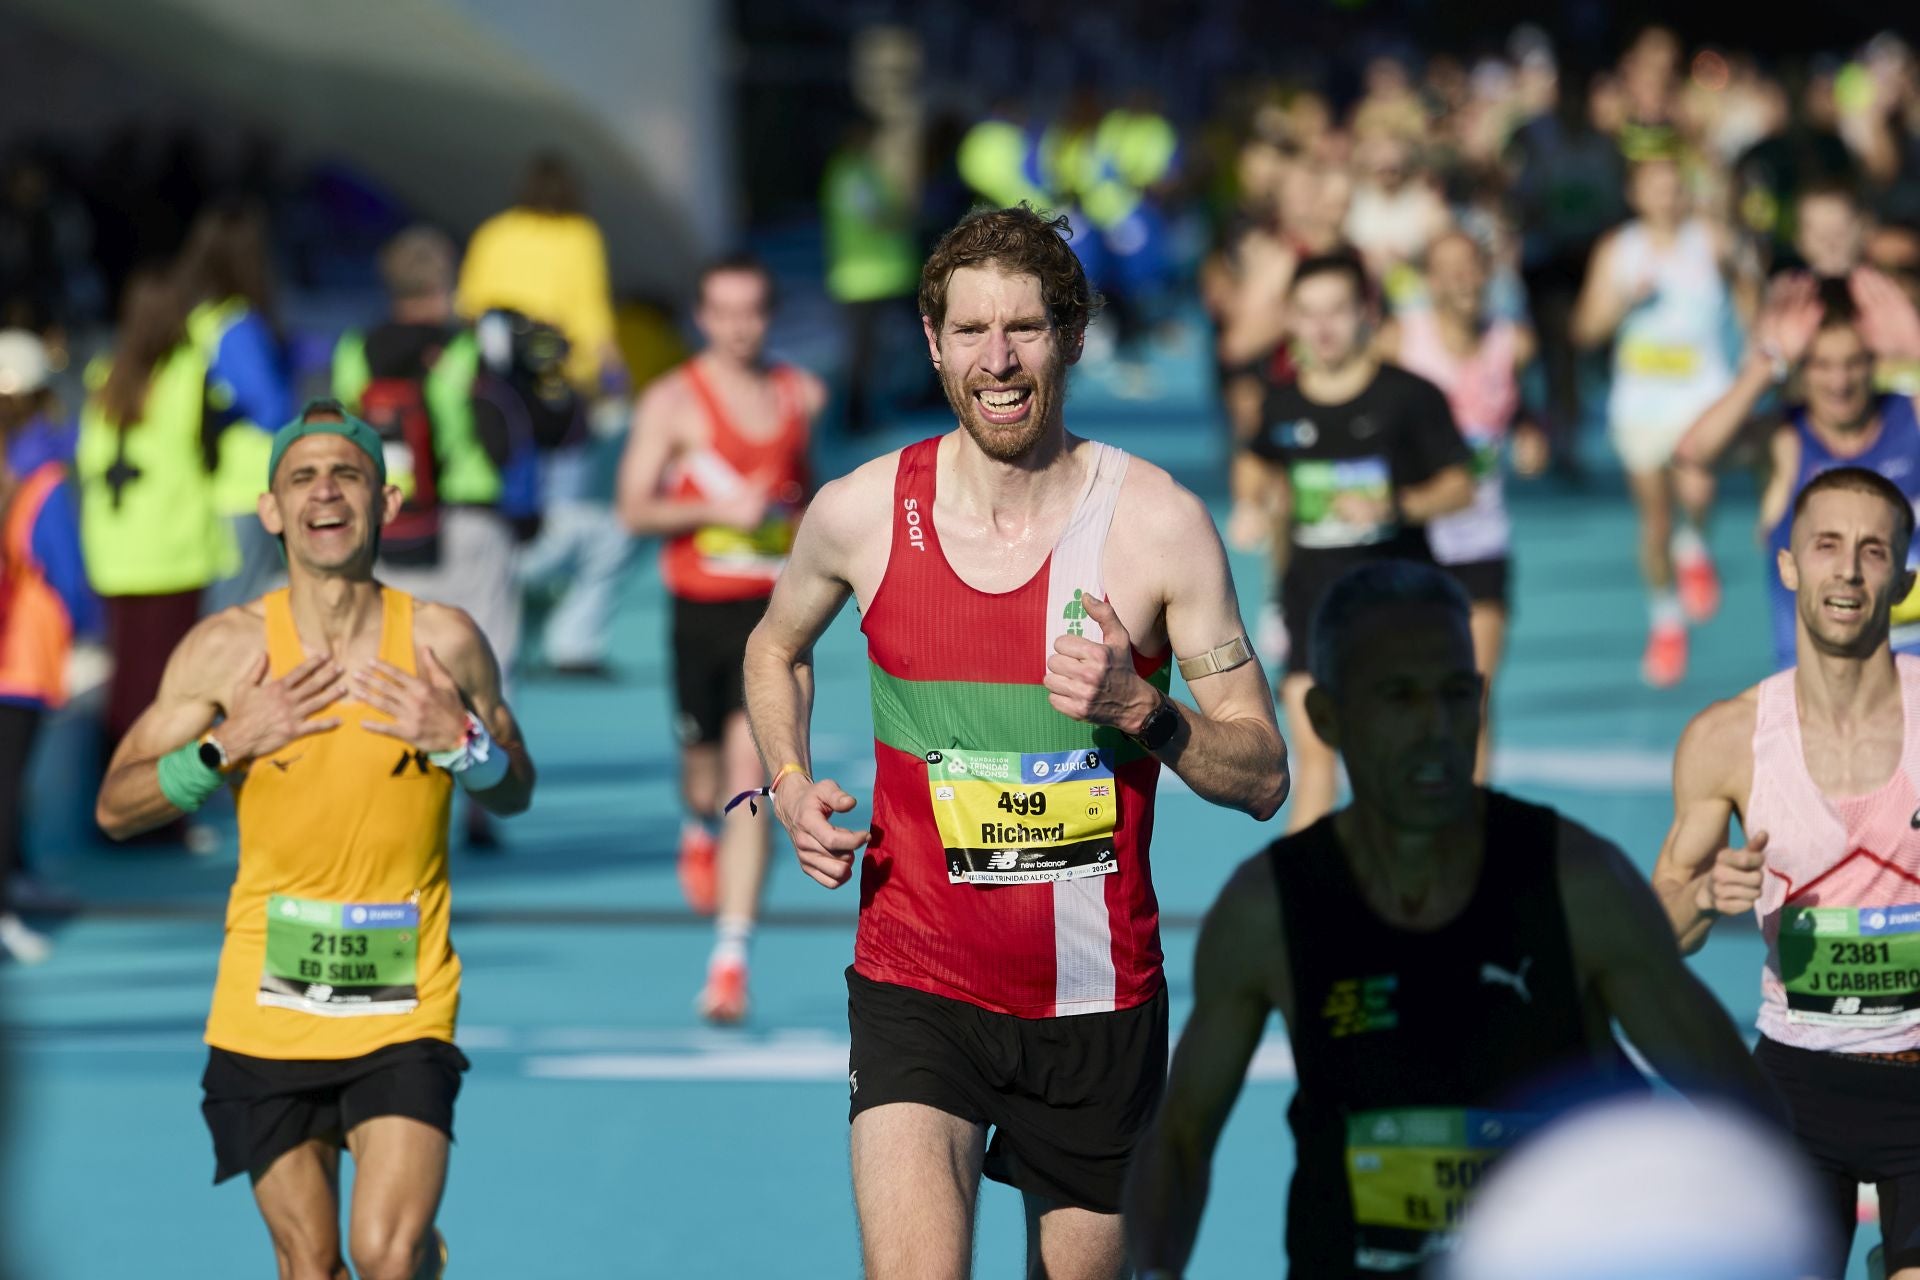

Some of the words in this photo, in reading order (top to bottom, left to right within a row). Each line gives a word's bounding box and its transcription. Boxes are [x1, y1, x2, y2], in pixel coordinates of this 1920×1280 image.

[904, 499, 925, 551] soar
[970, 762, 1009, 771] TRINIDAD
[970, 769, 1009, 779] ALFONSO
[1053, 760, 1090, 773] ZURIC
[997, 791, 1047, 816] 499
[1088, 807, 1098, 815] 01
[981, 822, 1065, 844] Richard
[1092, 864, 1108, 873] 2025
[310, 931, 369, 956] 2153
[1831, 942, 1889, 964] 2381
[299, 958, 321, 978] ED
[328, 962, 377, 981] SILVA
[1809, 973, 1820, 990] J
[1826, 970, 1920, 991] CABRERO
[1434, 1158, 1490, 1190] 50
